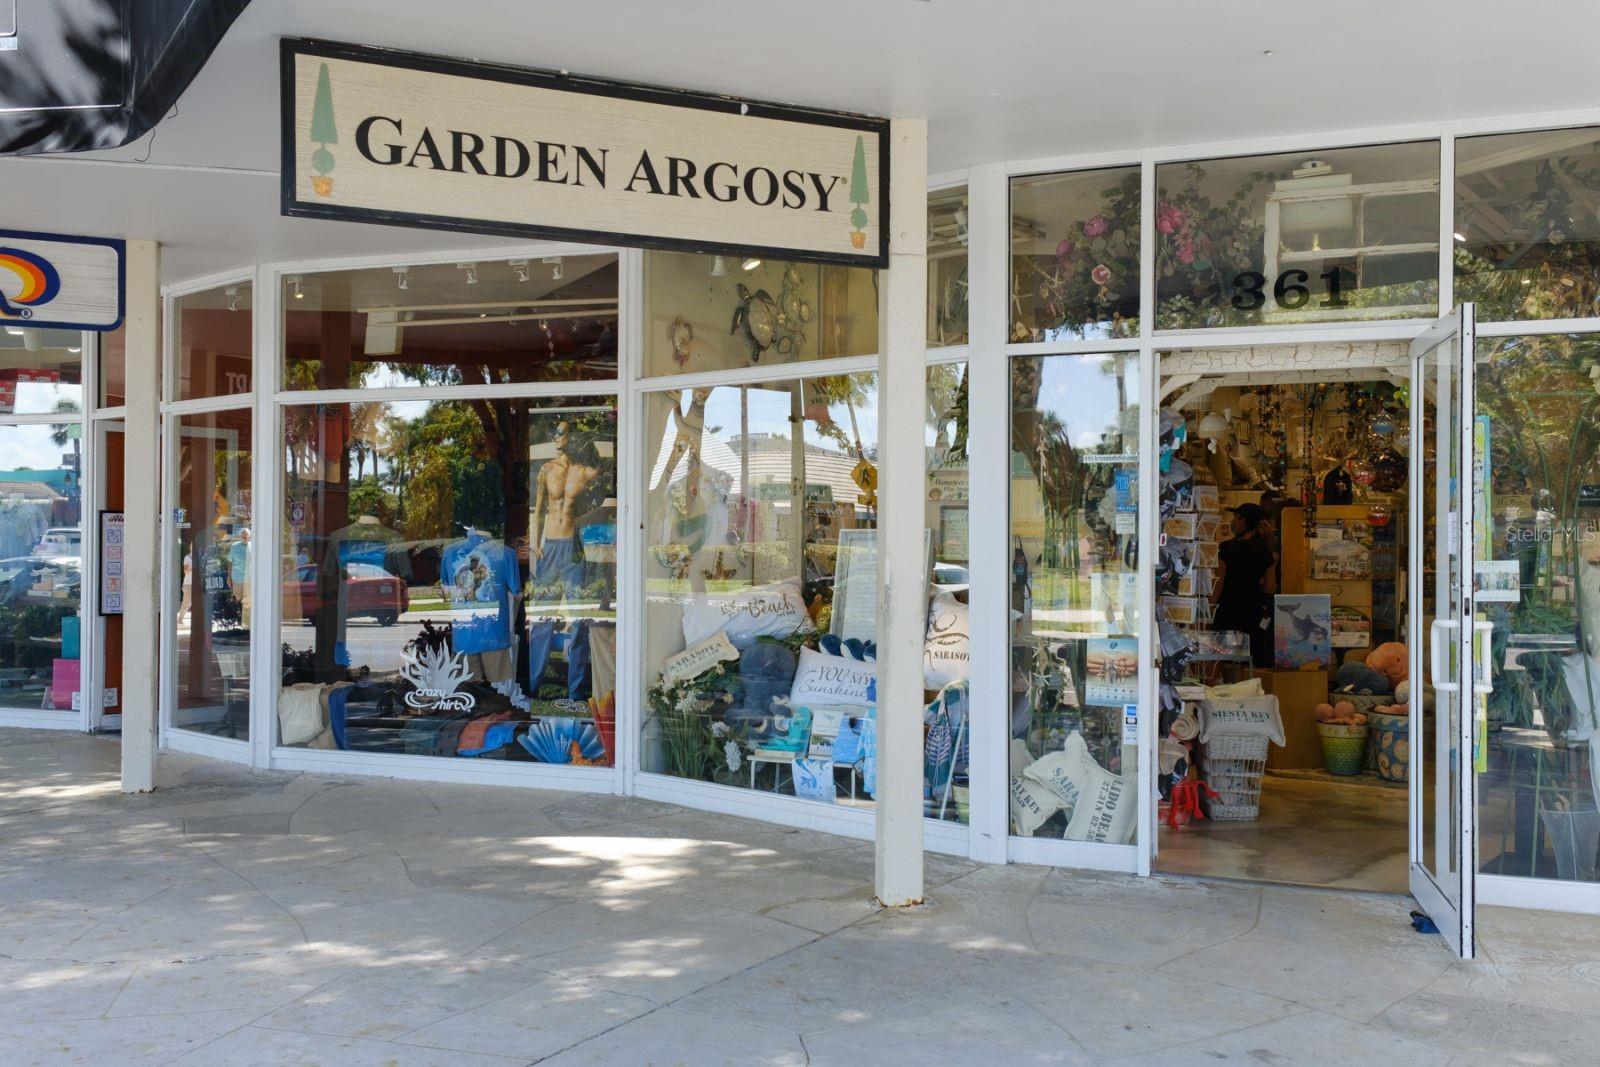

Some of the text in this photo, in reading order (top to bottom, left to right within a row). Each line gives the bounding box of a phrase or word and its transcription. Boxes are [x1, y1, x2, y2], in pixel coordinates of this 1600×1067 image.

[355, 115, 610, 190] GARDEN
[1230, 266, 1350, 311] 361
[1211, 710, 1248, 720] SIESTA
[1104, 779, 1124, 812] LIDO
